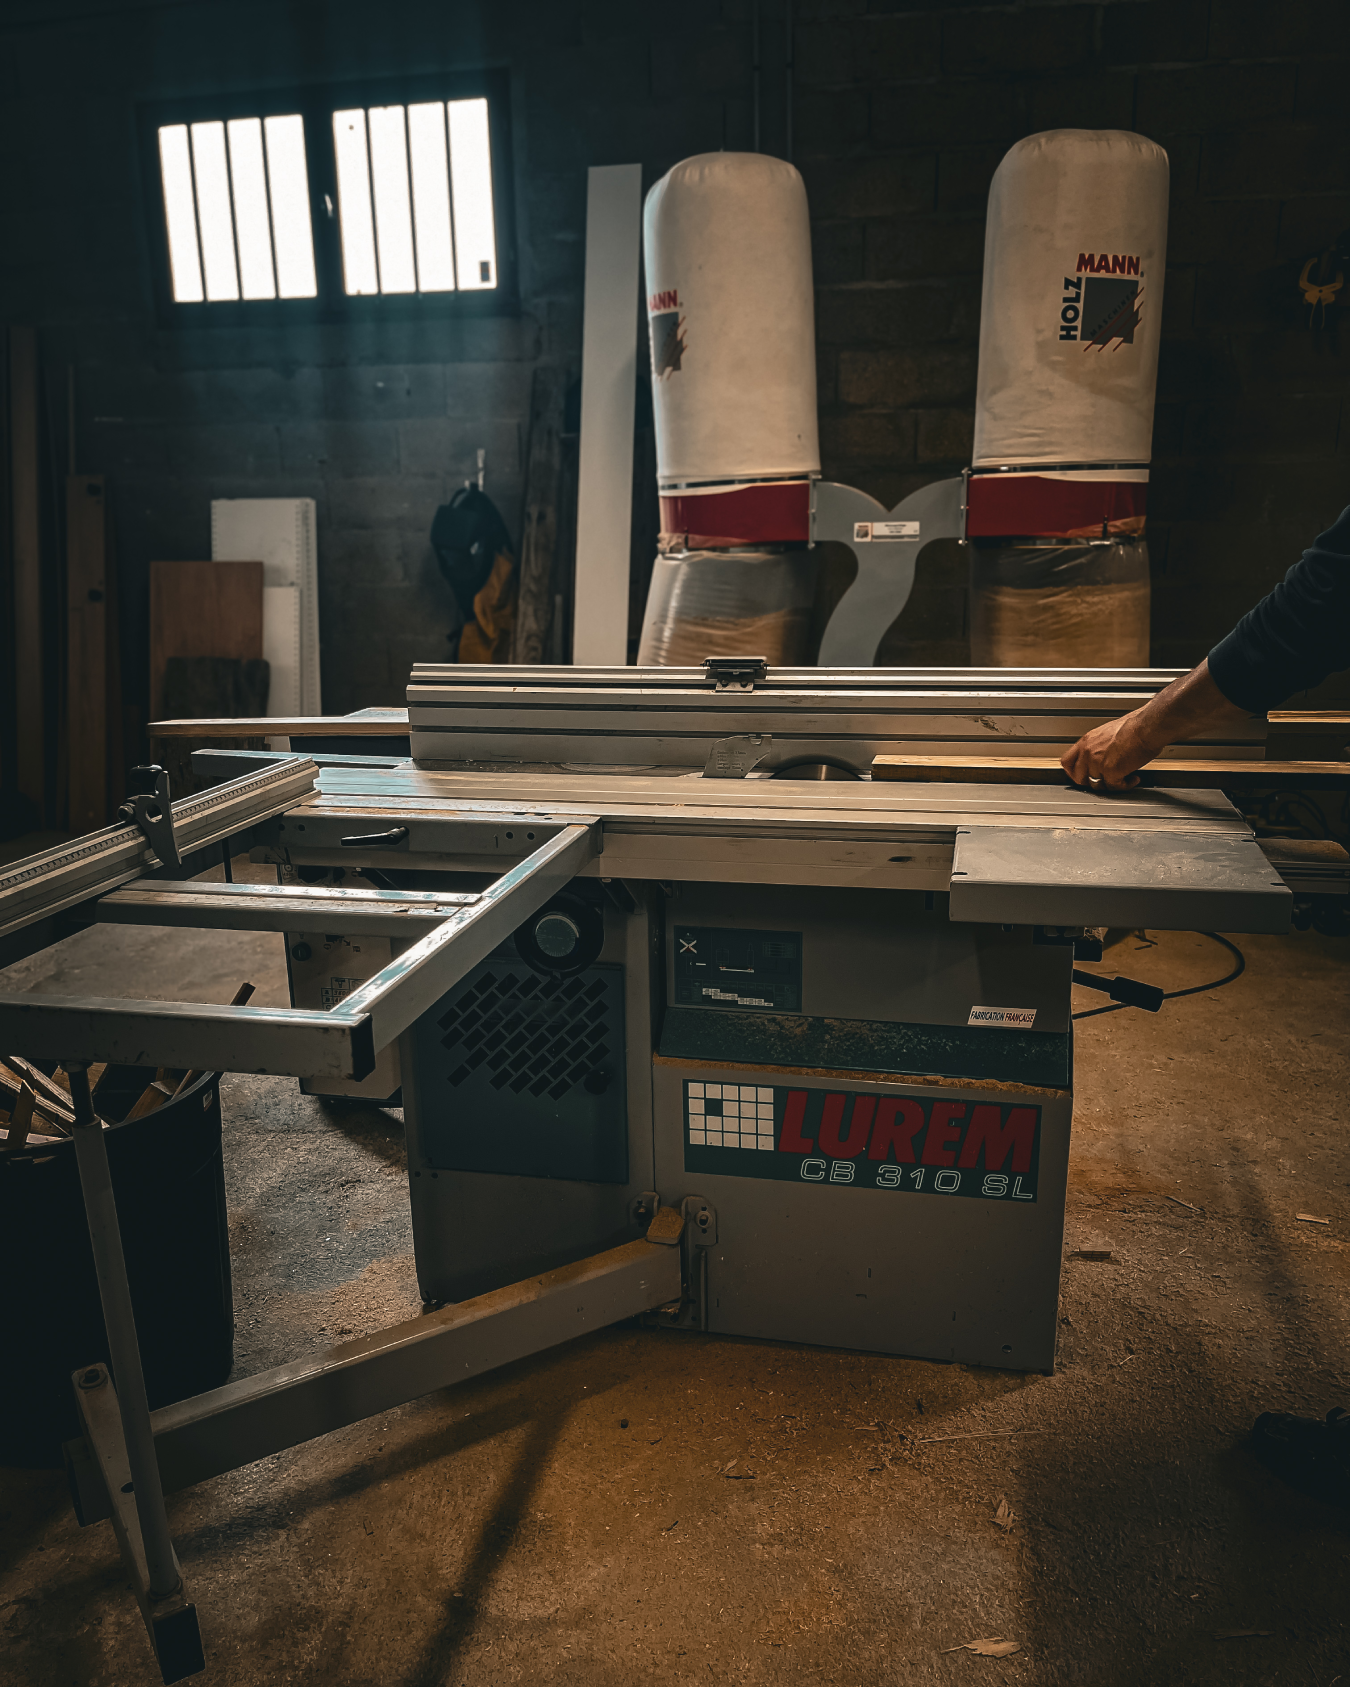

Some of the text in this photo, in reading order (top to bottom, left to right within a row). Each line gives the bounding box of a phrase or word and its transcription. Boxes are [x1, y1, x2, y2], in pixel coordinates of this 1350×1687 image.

[1076, 253, 1140, 275] MANN
[649, 289, 678, 311] ANN
[1059, 276, 1082, 341] HOLZ
[1089, 289, 1136, 338] MASCHINEN
[970, 1011, 1035, 1025] FABRICATION FRANÇAISE
[778, 1090, 1038, 1173] LUREM
[799, 1158, 1034, 1199] CB 310 SL
